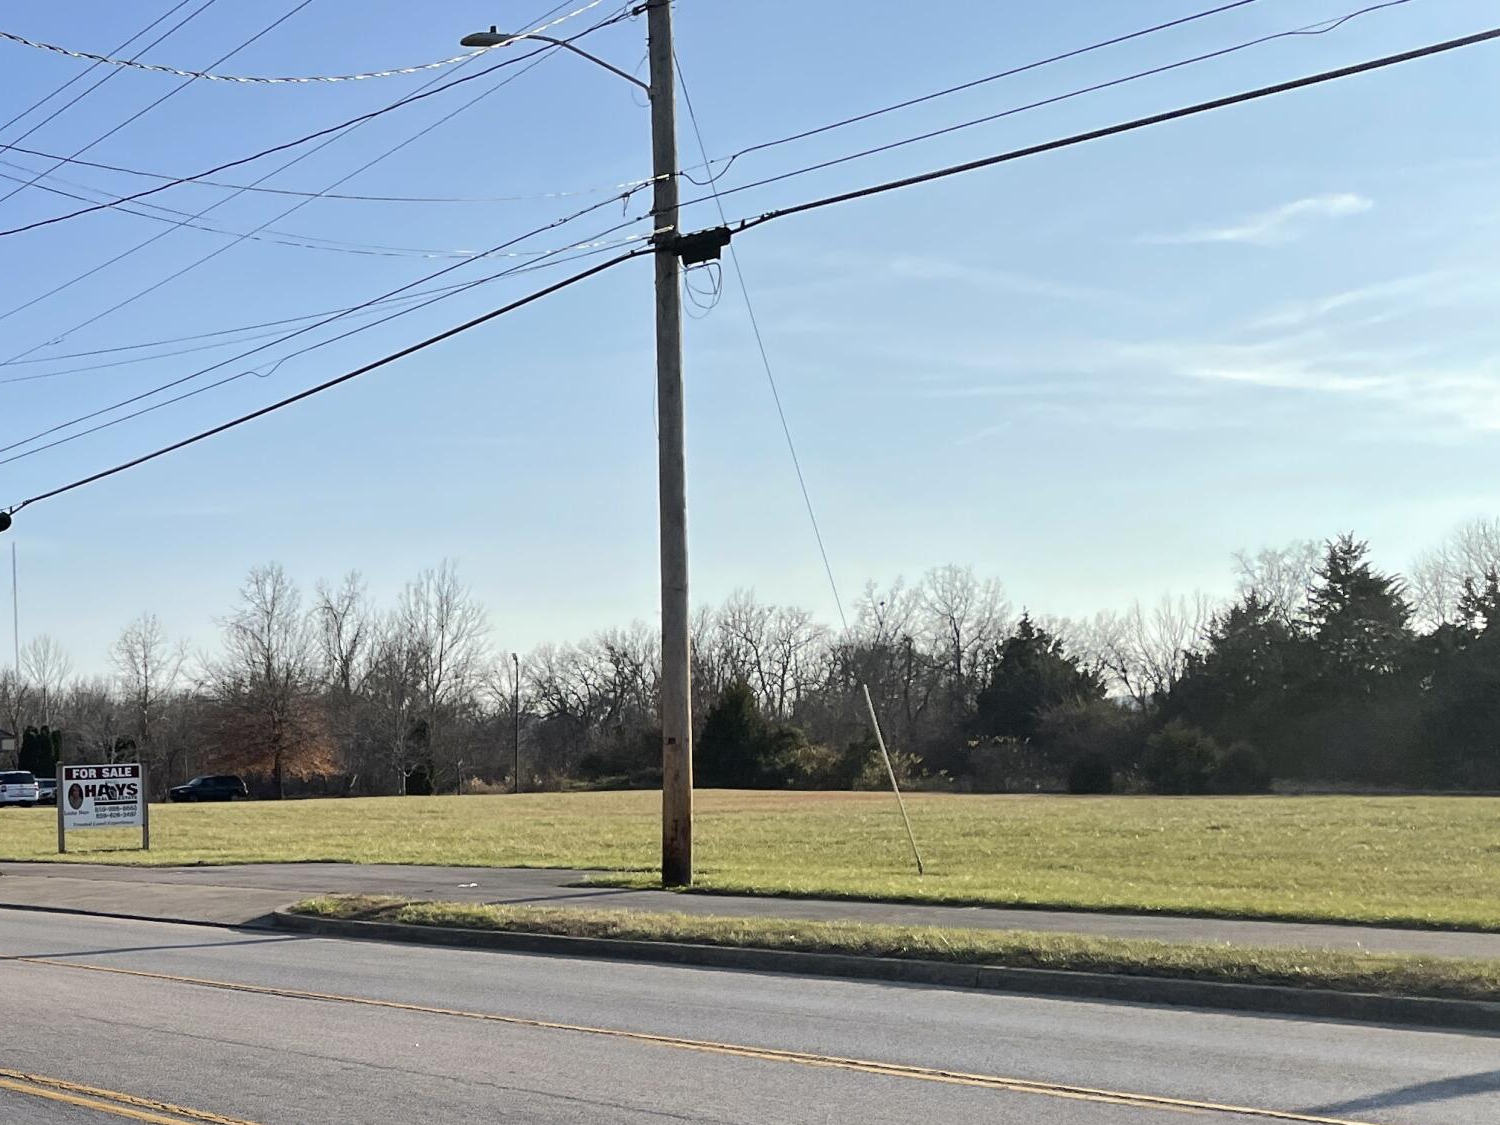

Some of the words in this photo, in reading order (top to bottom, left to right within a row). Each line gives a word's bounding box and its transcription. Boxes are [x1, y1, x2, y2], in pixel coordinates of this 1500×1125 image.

[72, 768, 97, 779] FOR
[101, 767, 132, 778] SALE
[84, 783, 138, 799] HAYS
